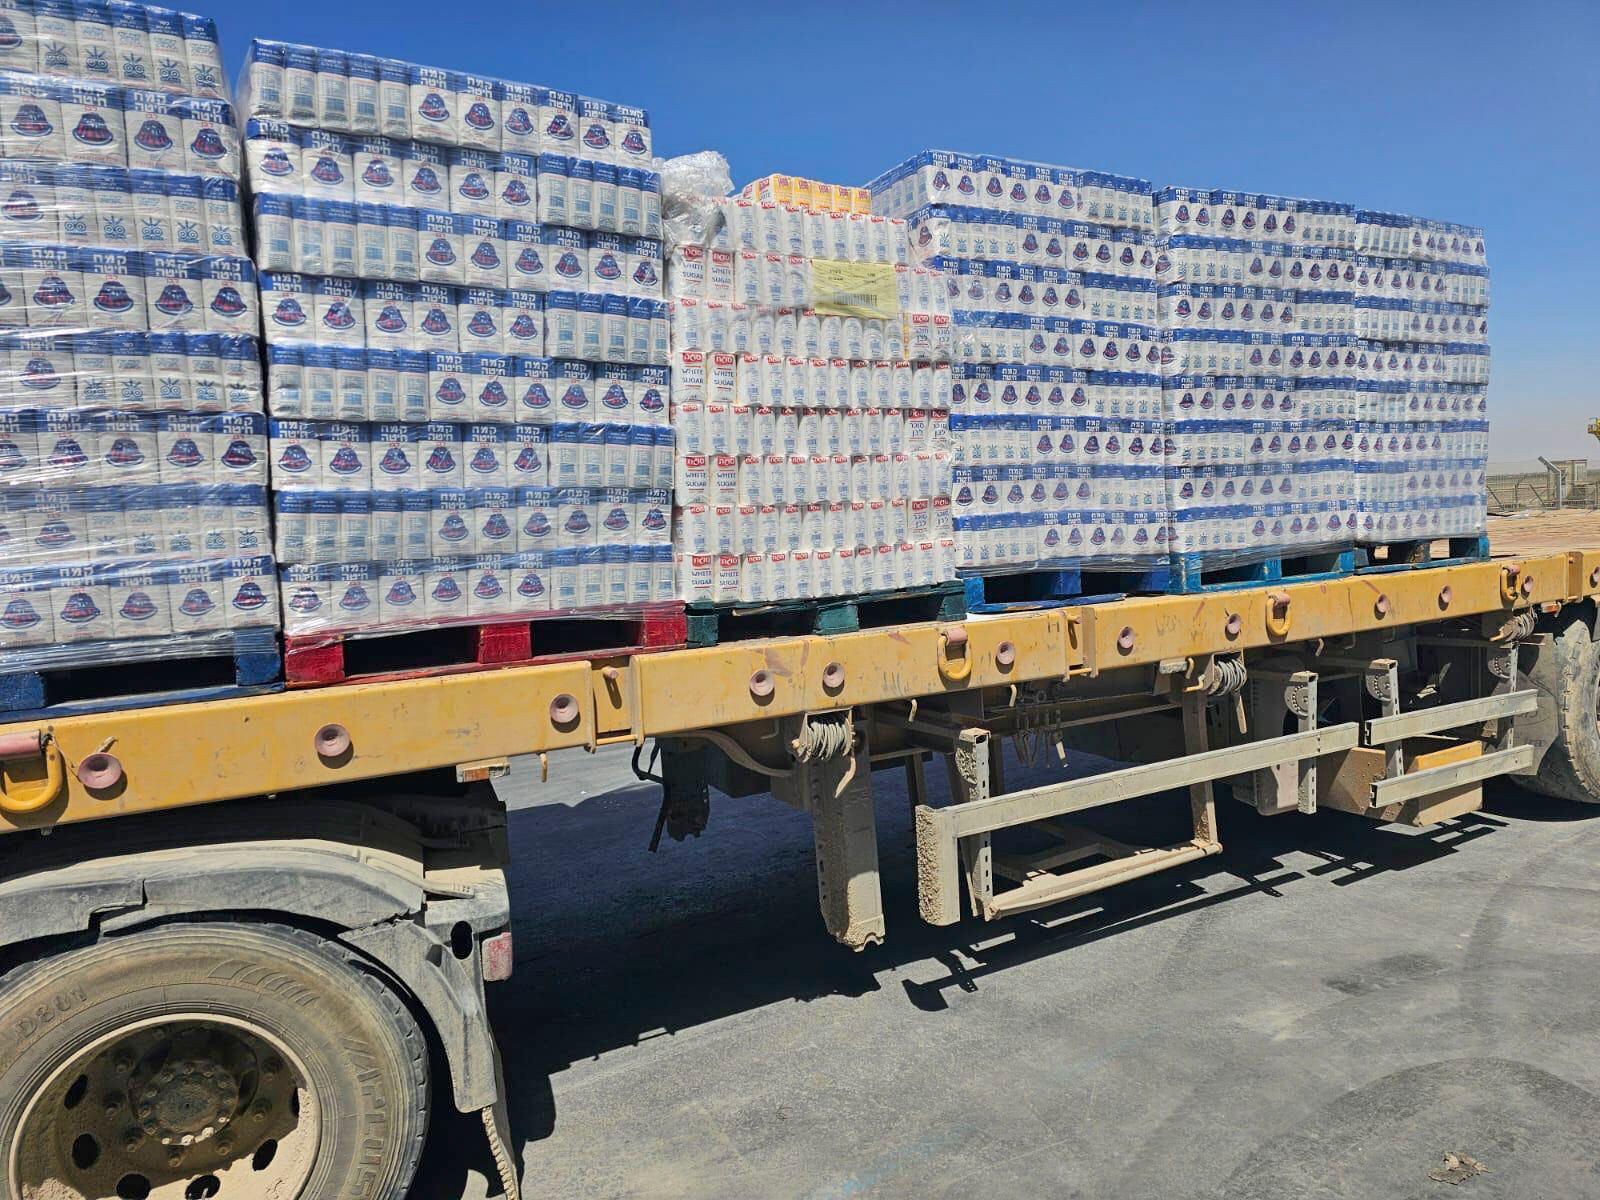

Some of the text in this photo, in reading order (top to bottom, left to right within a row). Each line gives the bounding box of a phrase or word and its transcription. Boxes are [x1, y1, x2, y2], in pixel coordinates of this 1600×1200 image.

[420, 68, 446, 80] קמח
[421, 77, 447, 89] חיטה
[467, 76, 493, 90] קמח
[467, 86, 493, 98] חיטה
[549, 90, 573, 102] קמח
[74, 94, 107, 107] חיטה
[134, 92, 167, 103] קמח
[135, 102, 167, 114] חיטה
[191, 100, 222, 112] קמח
[550, 99, 573, 111] חיטה
[584, 100, 607, 112] קמח
[192, 110, 222, 122] חיטה
[585, 108, 608, 119] חיטה
[504, 155, 528, 168] קמח
[504, 164, 529, 175] חיטה
[427, 214, 453, 226] קמח
[427, 223, 453, 234] חיטה
[517, 224, 540, 235] קמח
[517, 233, 540, 244] חיטה
[558, 229, 580, 240] קמח
[558, 238, 580, 249] חיטה
[636, 240, 657, 251] קמח
[32, 250, 67, 260] קמח
[636, 248, 657, 259] חיטה
[93, 254, 127, 265] קמח
[155, 258, 187, 269] קמח
[33, 260, 68, 270] חיטה
[94, 264, 127, 274] חיטה
[211, 261, 240, 271] קמח
[683, 262, 703, 271] WHITE
[155, 268, 188, 278] חיטה
[211, 270, 241, 281] חיטה
[712, 266, 731, 275] WHITE
[272, 274, 301, 283] קמח
[683, 272, 703, 280] SUGAR
[712, 276, 731, 284] SUGAR
[273, 283, 302, 292] חיטה
[324, 278, 352, 288] קמח
[325, 287, 352, 296] חיטה
[422, 285, 447, 295] קמח
[423, 294, 448, 303] חיטה
[437, 355, 462, 364] קמח
[437, 363, 463, 372] חיטה
[525, 361, 548, 371] קמח
[525, 369, 549, 379] חיטה
[605, 371, 627, 380] חיטה
[47, 413, 80, 423] קמח
[222, 415, 253, 426] קמח
[48, 423, 81, 431] חיטה
[106, 423, 139, 432] חיטה
[168, 423, 200, 432] חיטה
[223, 425, 254, 434] חיטה
[279, 422, 308, 431] קמח
[516, 426, 540, 435] קמח
[280, 430, 308, 438] חיטה
[381, 433, 408, 441] חיטה
[516, 433, 540, 442] חיטה
[607, 488, 629, 496] קמח
[440, 493, 466, 502] קמח
[607, 495, 629, 503] חיטה
[441, 501, 466, 509] חיטה
[520, 553, 543, 562] קמח
[232, 558, 262, 568] קמח
[520, 561, 543, 569] חיטה
[60, 567, 94, 577] קמח
[233, 567, 262, 576] חיטה
[341, 564, 367, 573] קמח
[387, 567, 413, 576] חיטה
[61, 577, 94, 587] חיטה
[120, 576, 152, 586] חיטה
[179, 573, 210, 583] חיטה
[342, 573, 368, 581] חיטה
